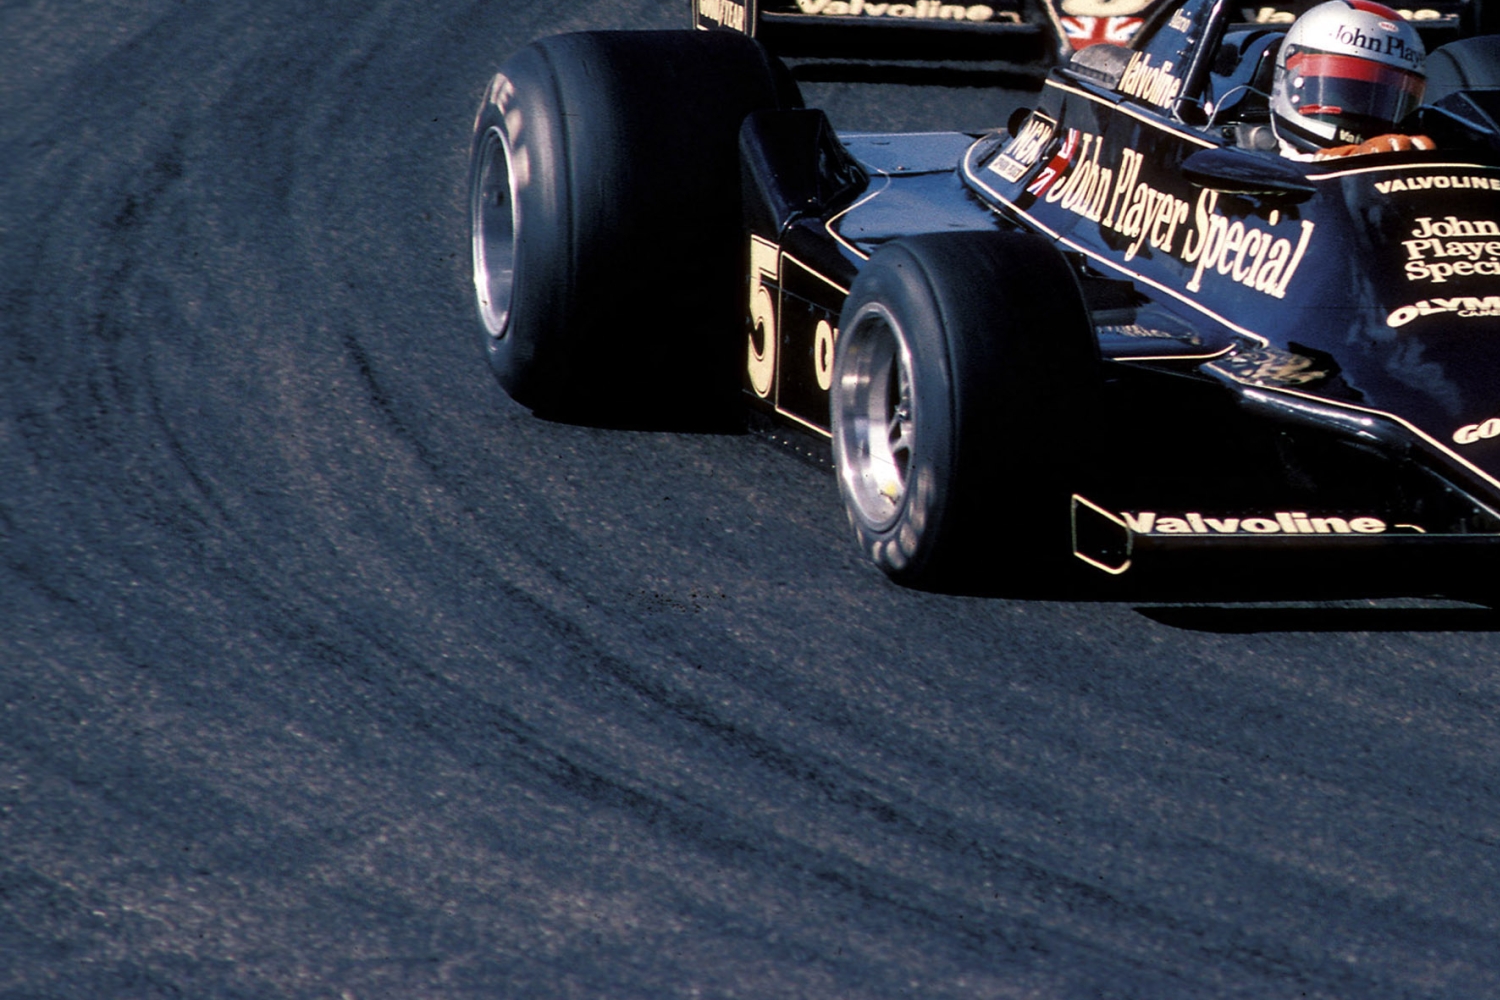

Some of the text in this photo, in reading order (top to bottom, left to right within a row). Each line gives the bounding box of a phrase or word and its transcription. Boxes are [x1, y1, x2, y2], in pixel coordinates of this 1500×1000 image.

[1118, 51, 1182, 110] Valvoline
[1046, 132, 1315, 299] John Player Special
[747, 233, 780, 399] 5
[1124, 512, 1386, 533] Valvoline
